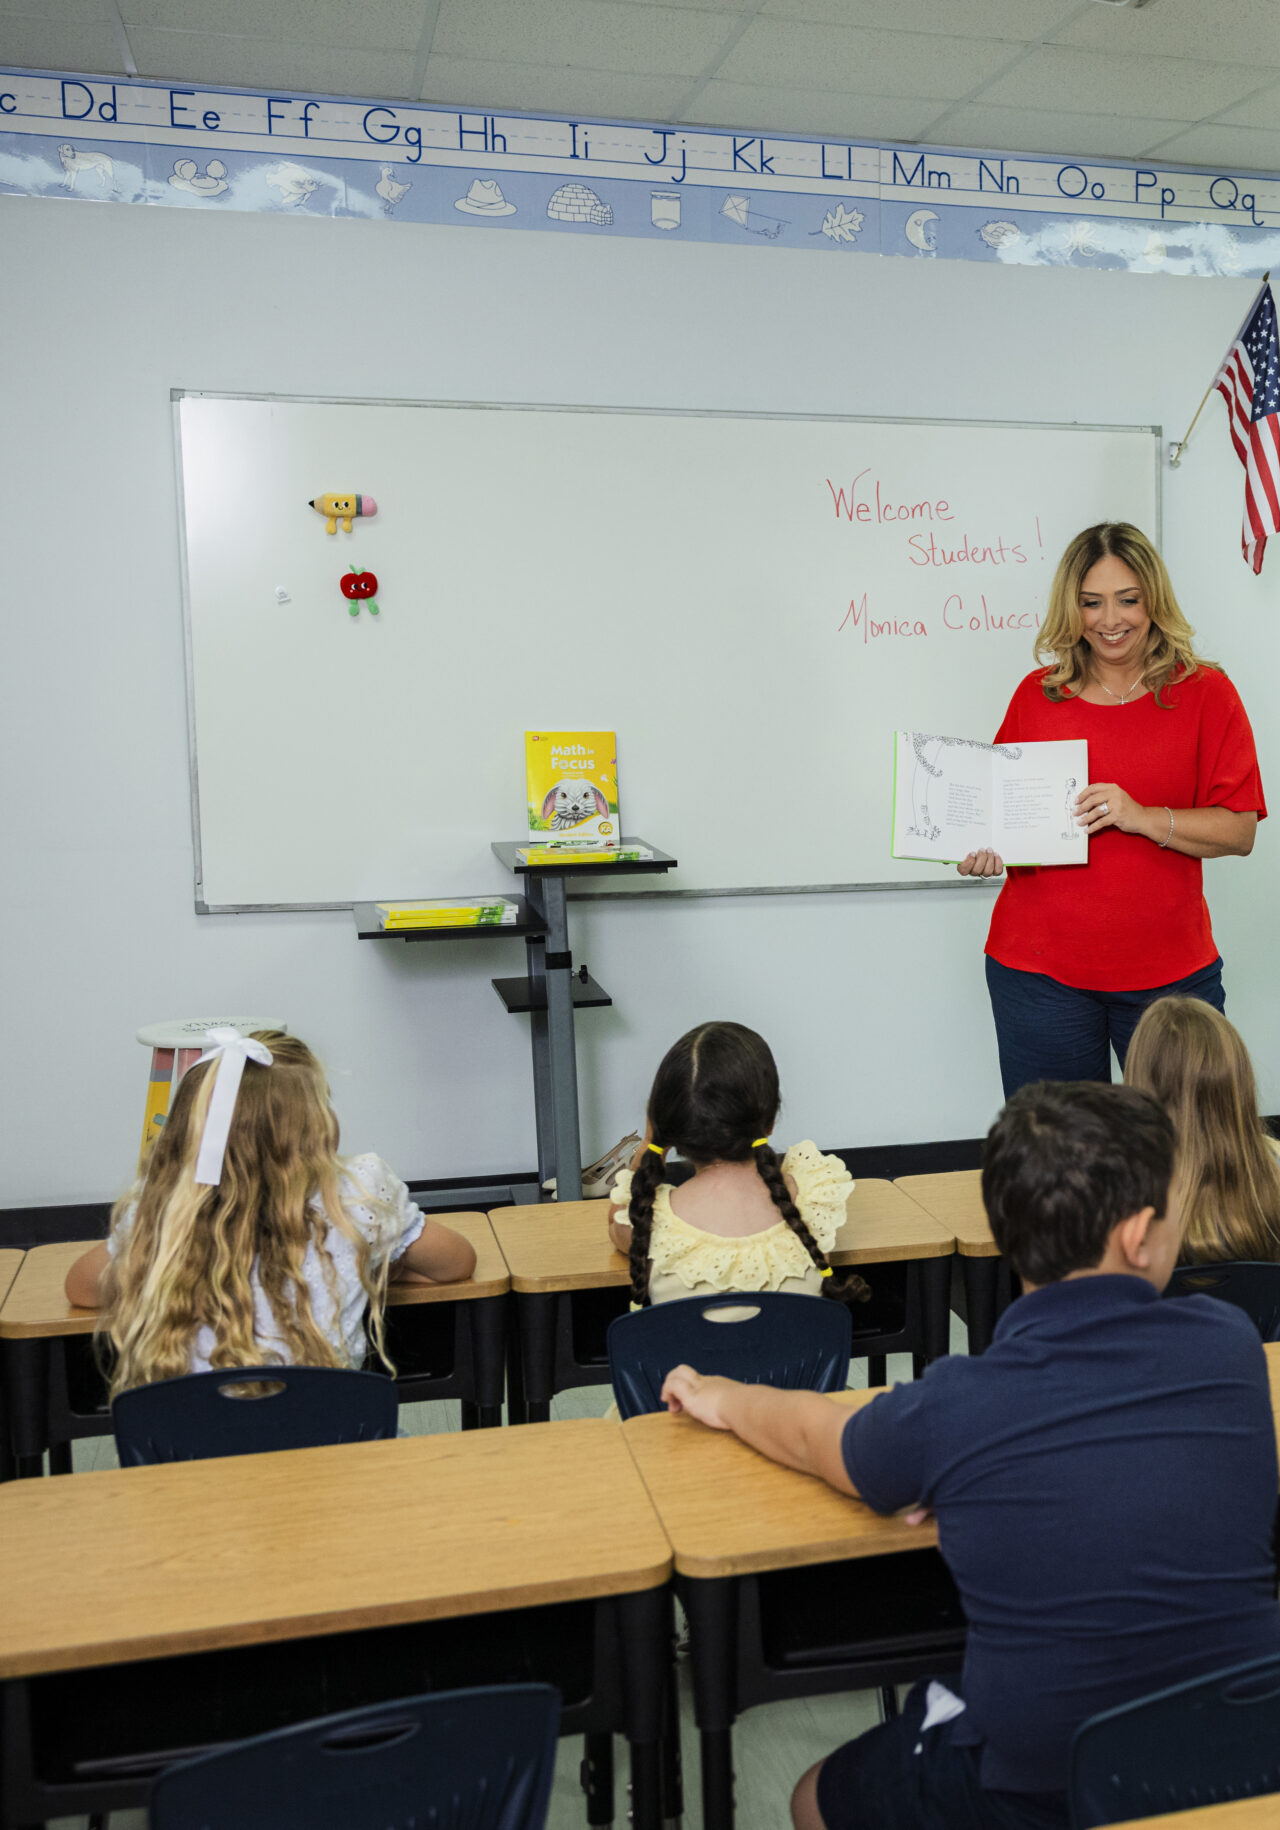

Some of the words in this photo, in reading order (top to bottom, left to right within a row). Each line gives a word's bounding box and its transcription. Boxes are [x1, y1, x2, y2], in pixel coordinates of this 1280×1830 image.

[61, 81, 118, 122] Dd
[170, 91, 221, 130] Ee
[267, 98, 321, 137] Ff
[363, 107, 422, 163] Gg
[458, 114, 507, 153] Hh
[568, 123, 589, 159] Ii
[644, 131, 686, 183] Jj
[733, 137, 775, 174] Kk
[822, 145, 852, 180] Ll
[893, 152, 951, 188] Mm
[979, 159, 1020, 194] Nn
[1057, 165, 1105, 199] Oo
[1136, 171, 1175, 218] Pp
[1209, 177, 1265, 226] Qq
[826, 467, 955, 524] Welcome
[838, 592, 928, 644] Monica
[943, 594, 1041, 631] Colucci
[551, 744, 585, 756] Math
[551, 757, 595, 770] Focus
